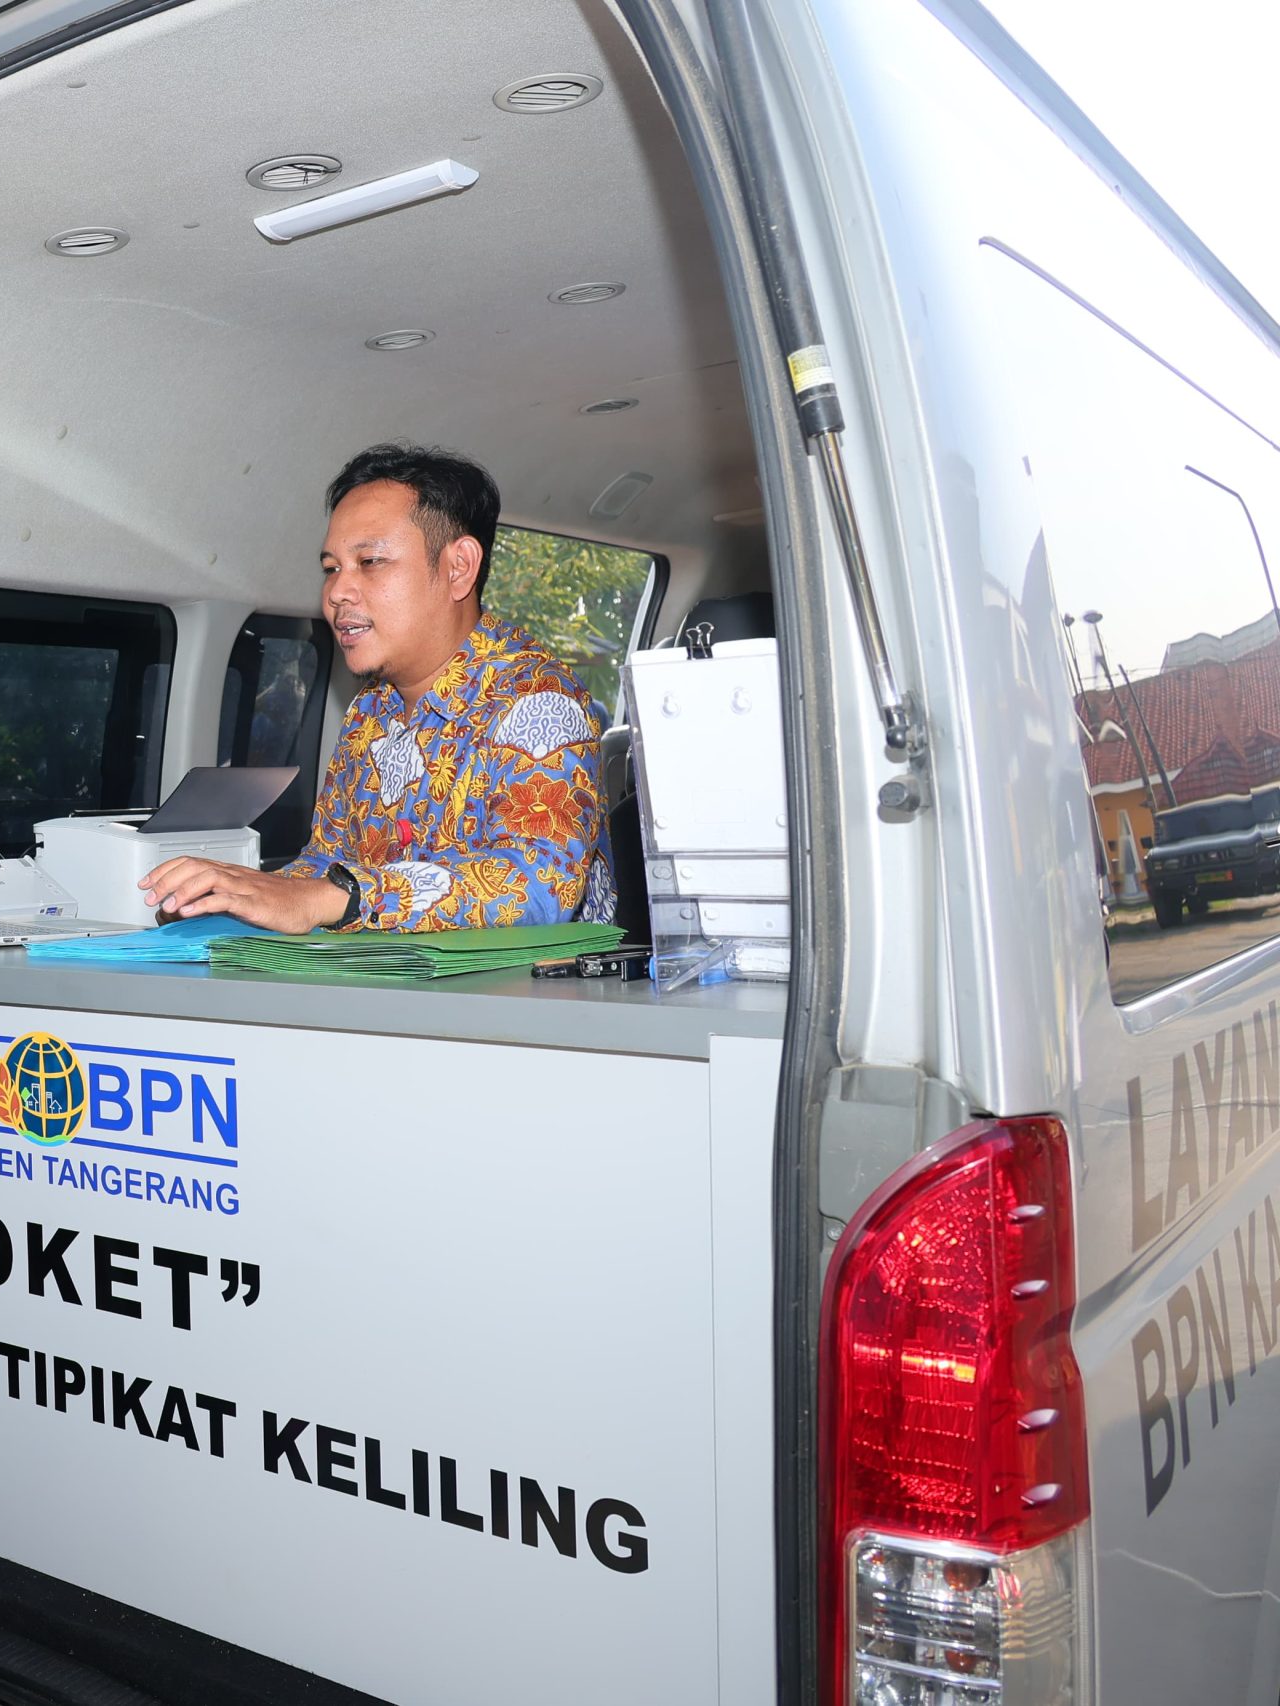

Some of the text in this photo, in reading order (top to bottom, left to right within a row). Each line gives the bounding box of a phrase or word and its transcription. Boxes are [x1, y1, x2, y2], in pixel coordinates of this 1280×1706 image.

[88, 1062, 239, 1149] BPN
[41, 1155, 240, 1216] TANGERANG
[1131, 1247, 1236, 1518] BPN
[262, 1410, 649, 1574] KELILING
